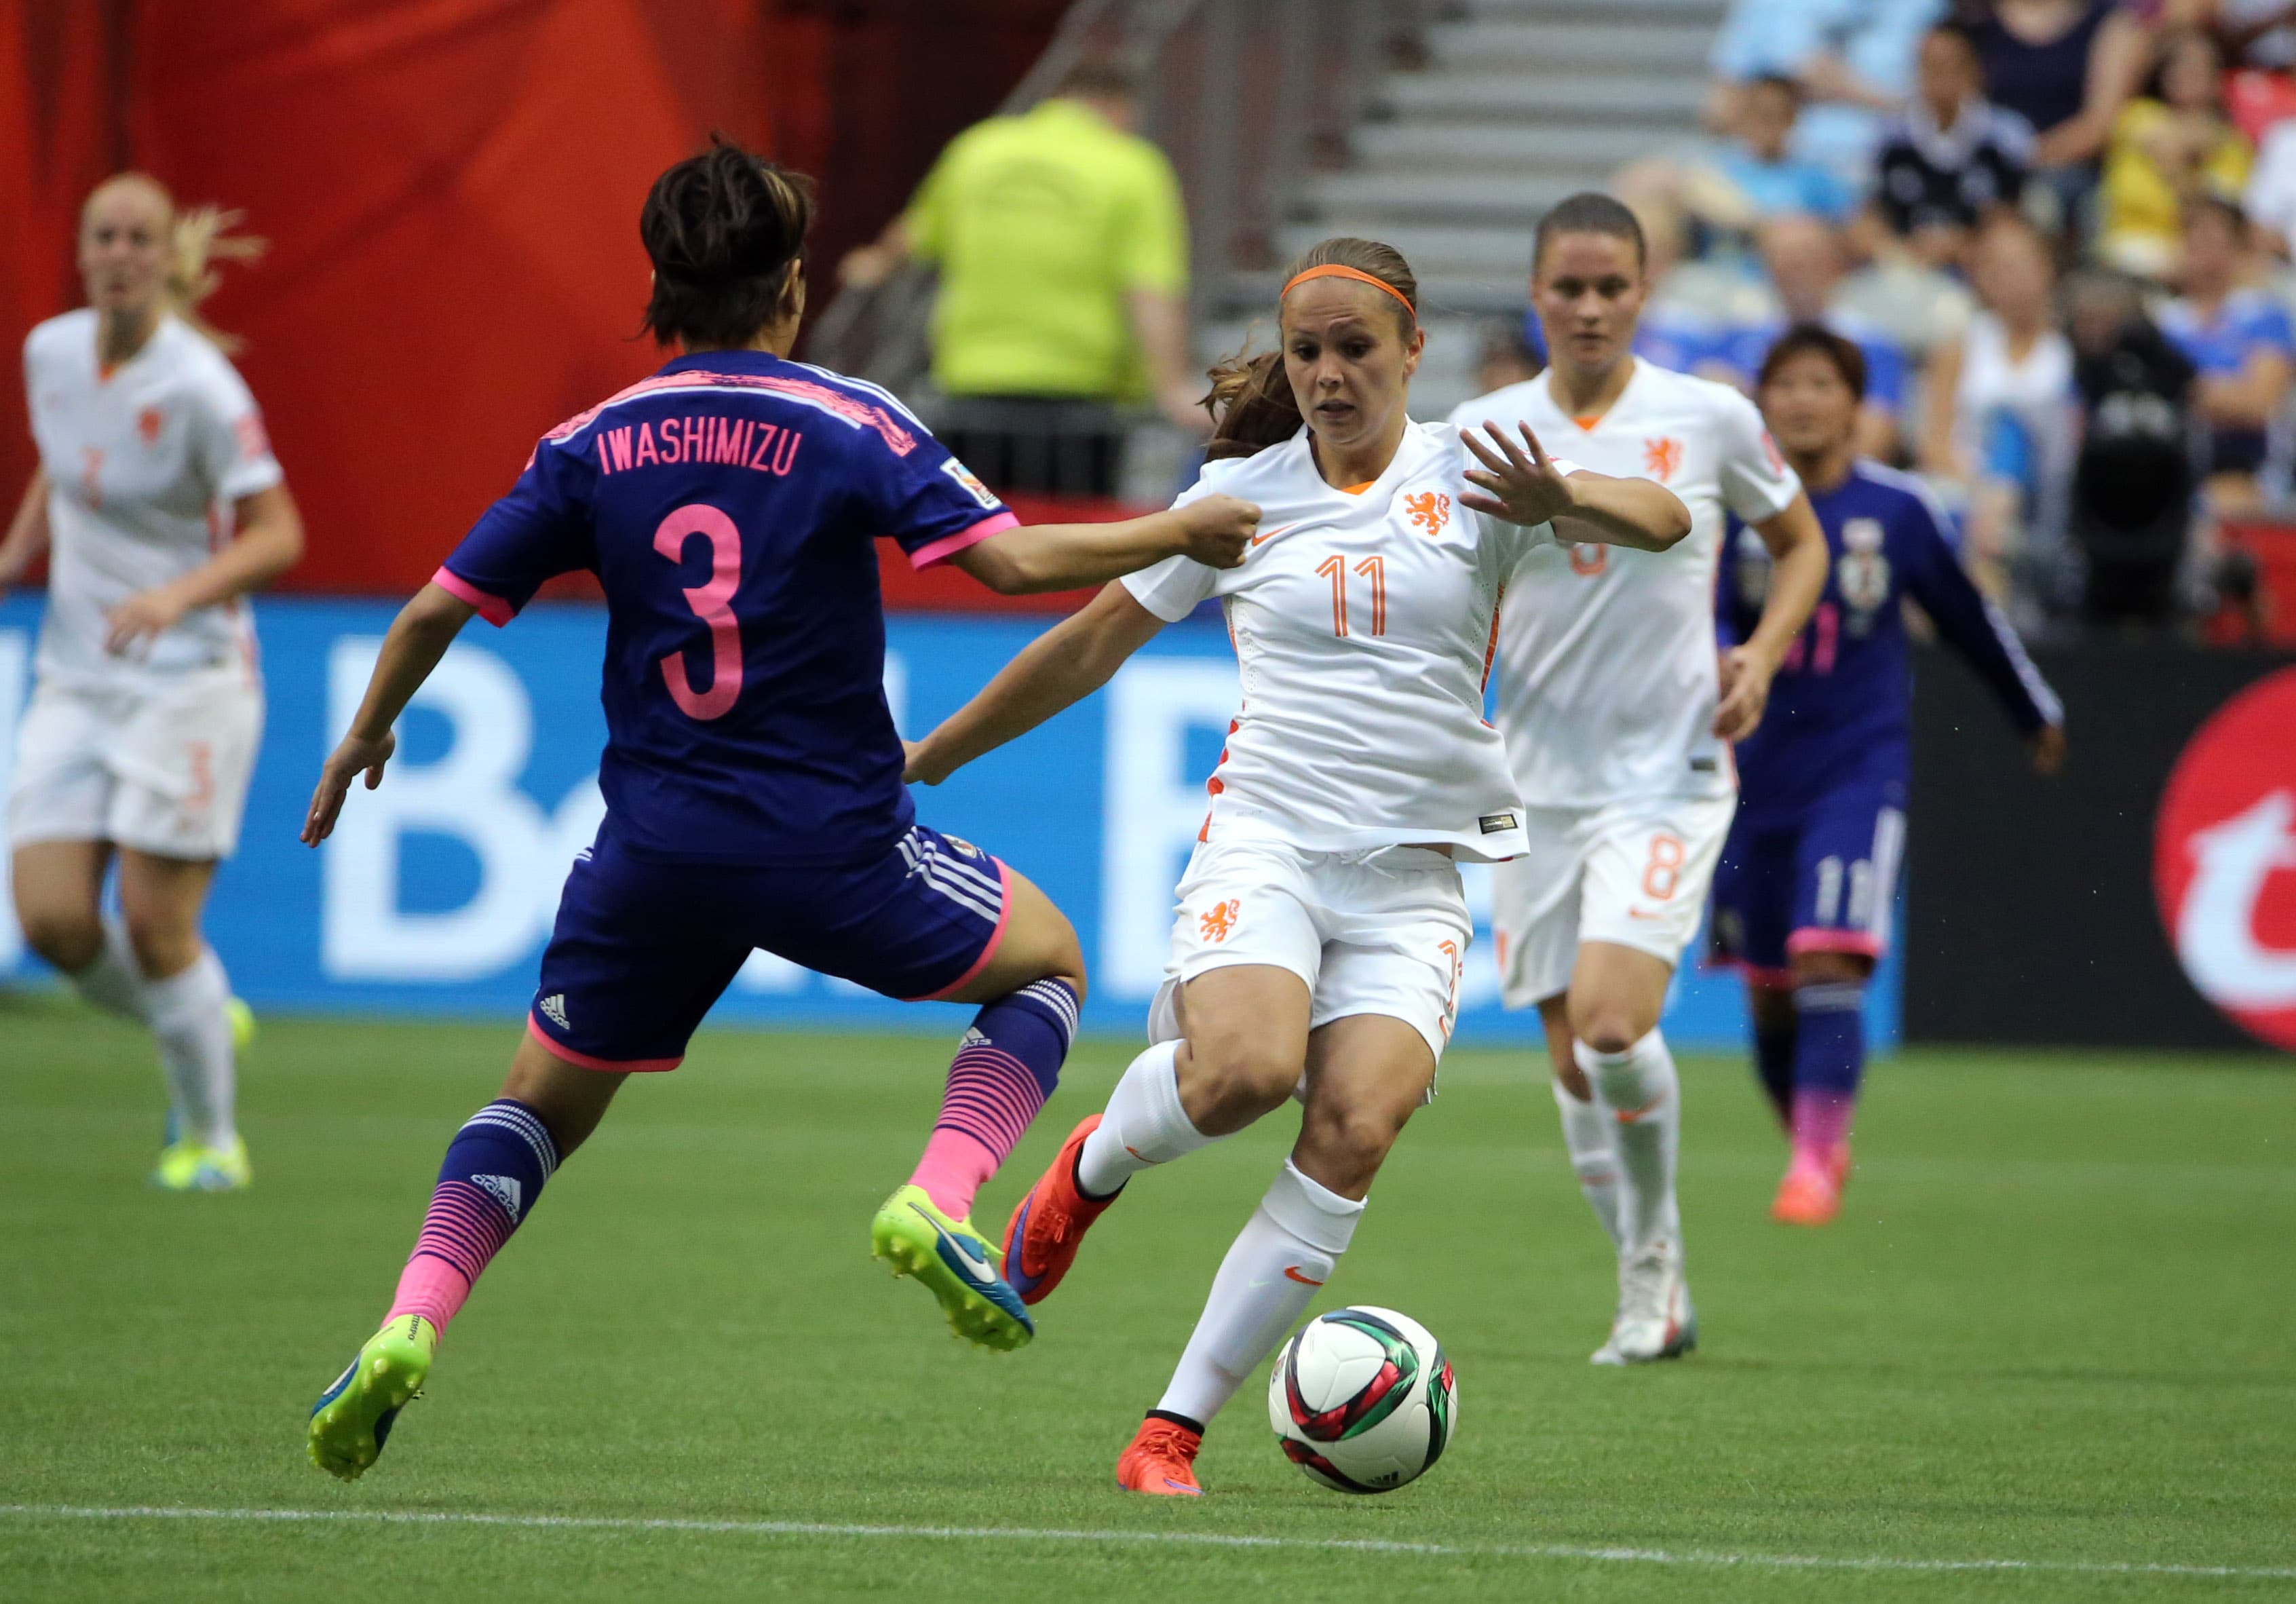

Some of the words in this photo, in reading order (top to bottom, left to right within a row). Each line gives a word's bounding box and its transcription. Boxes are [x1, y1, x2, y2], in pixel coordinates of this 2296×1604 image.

[597, 416, 803, 476] IWASHIMIZU
[653, 503, 743, 721] 3
[1314, 554, 1386, 638] 11
[1640, 833, 1687, 902] 8
[539, 999, 571, 1031] adidas
[470, 1174, 519, 1224] adidas
